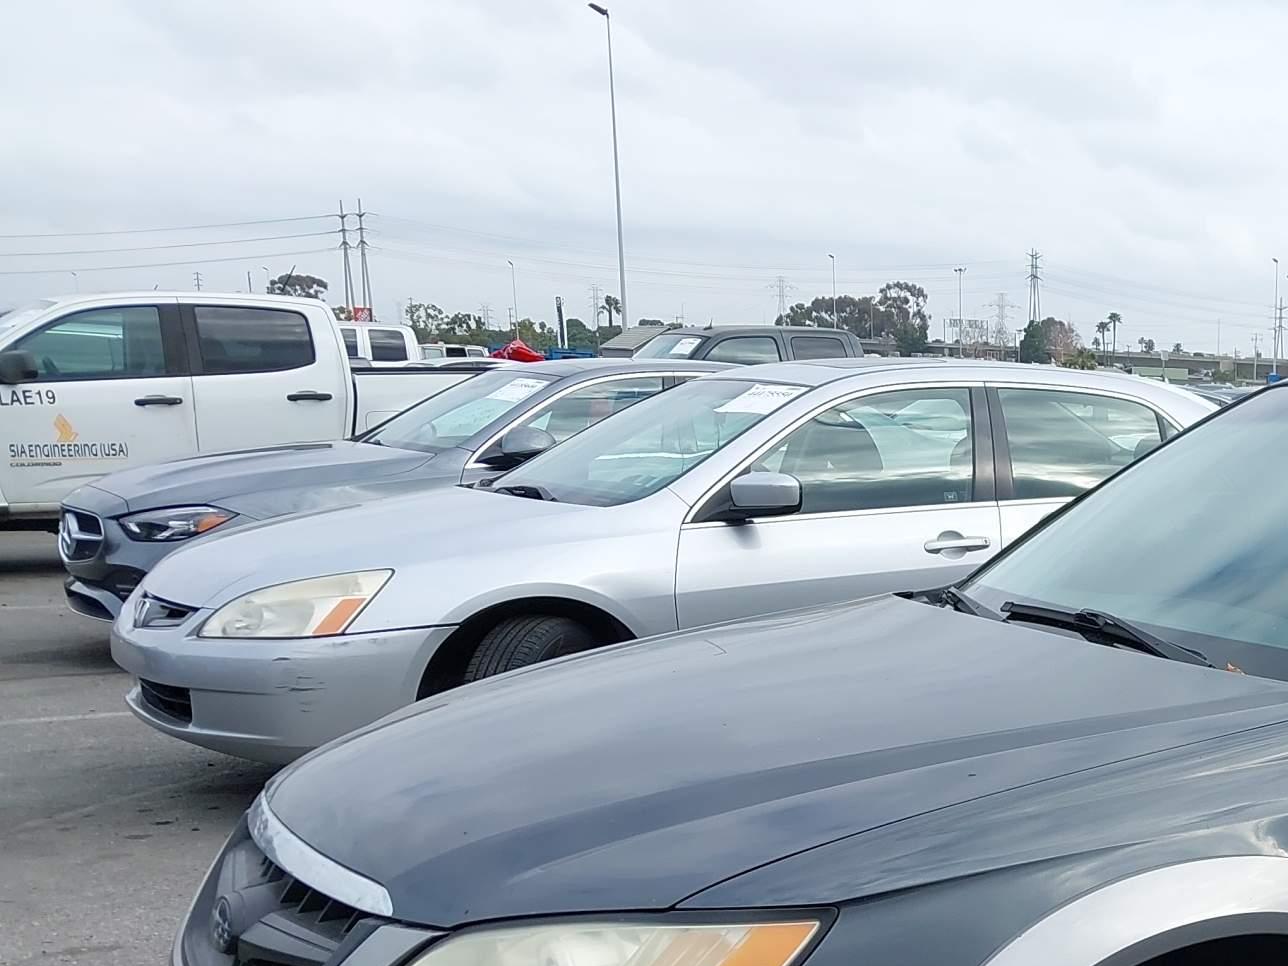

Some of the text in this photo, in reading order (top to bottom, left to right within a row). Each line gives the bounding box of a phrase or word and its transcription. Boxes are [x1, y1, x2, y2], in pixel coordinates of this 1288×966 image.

[9, 443, 129, 458] SIA ENGINEERING (USA)
